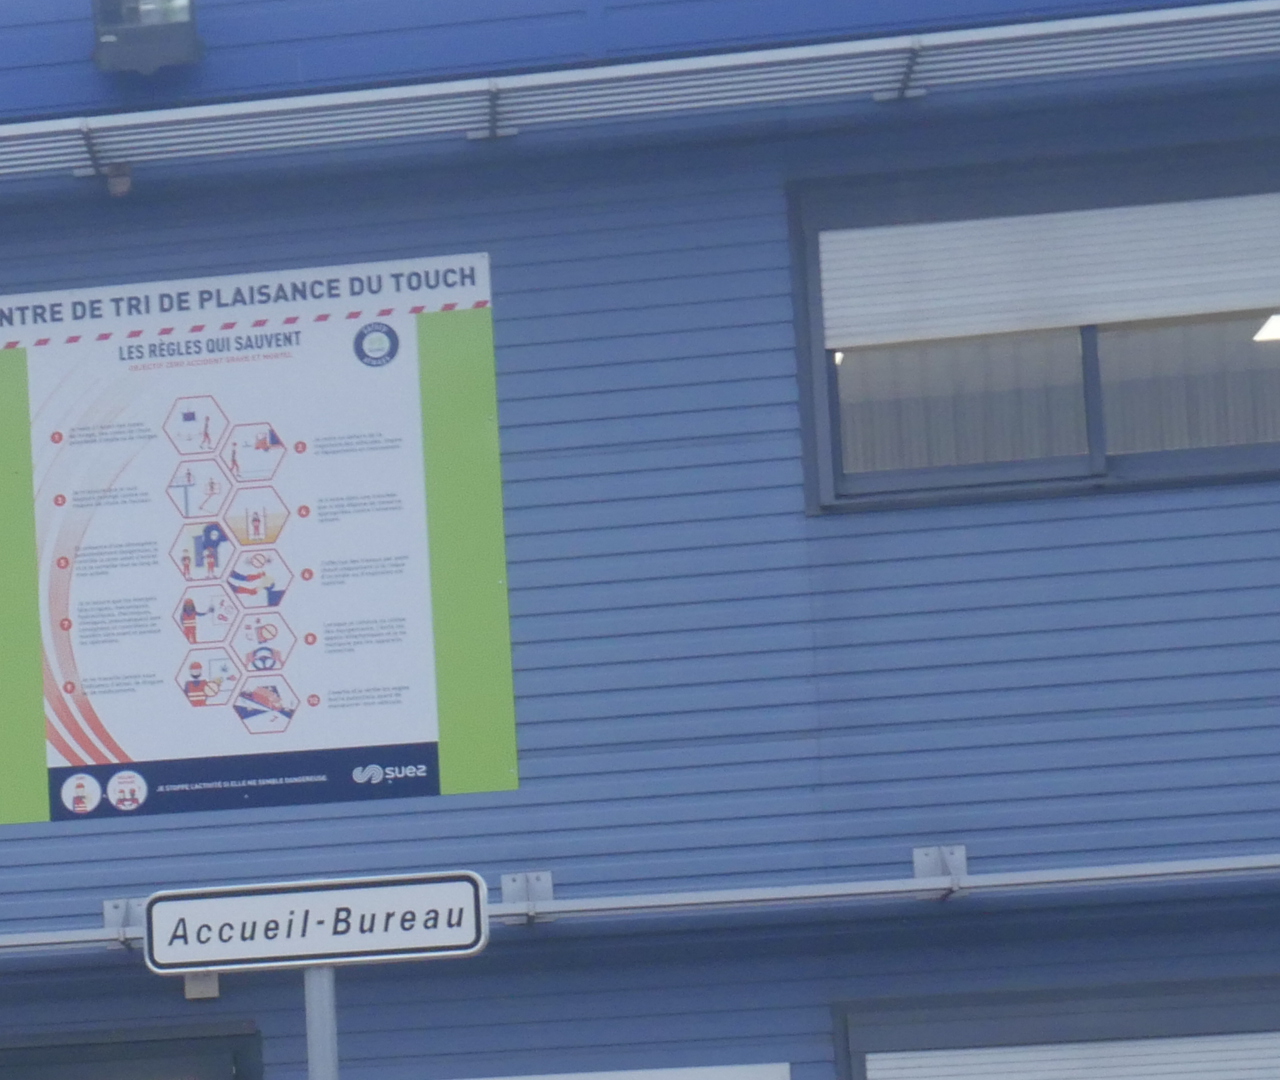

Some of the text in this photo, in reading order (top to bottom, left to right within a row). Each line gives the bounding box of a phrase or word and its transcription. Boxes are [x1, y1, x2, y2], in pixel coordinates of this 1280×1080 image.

[72, 299, 103, 321] DE
[110, 295, 151, 317] TRI
[159, 291, 190, 313] DE
[199, 278, 341, 310] PLAISANCE
[349, 274, 383, 296] DU
[389, 266, 477, 292] TOUCH
[119, 330, 302, 361] LES RÈGLES QUI SAUVENT
[384, 764, 428, 779] suez
[168, 906, 465, 947] Accueil-Bureau
